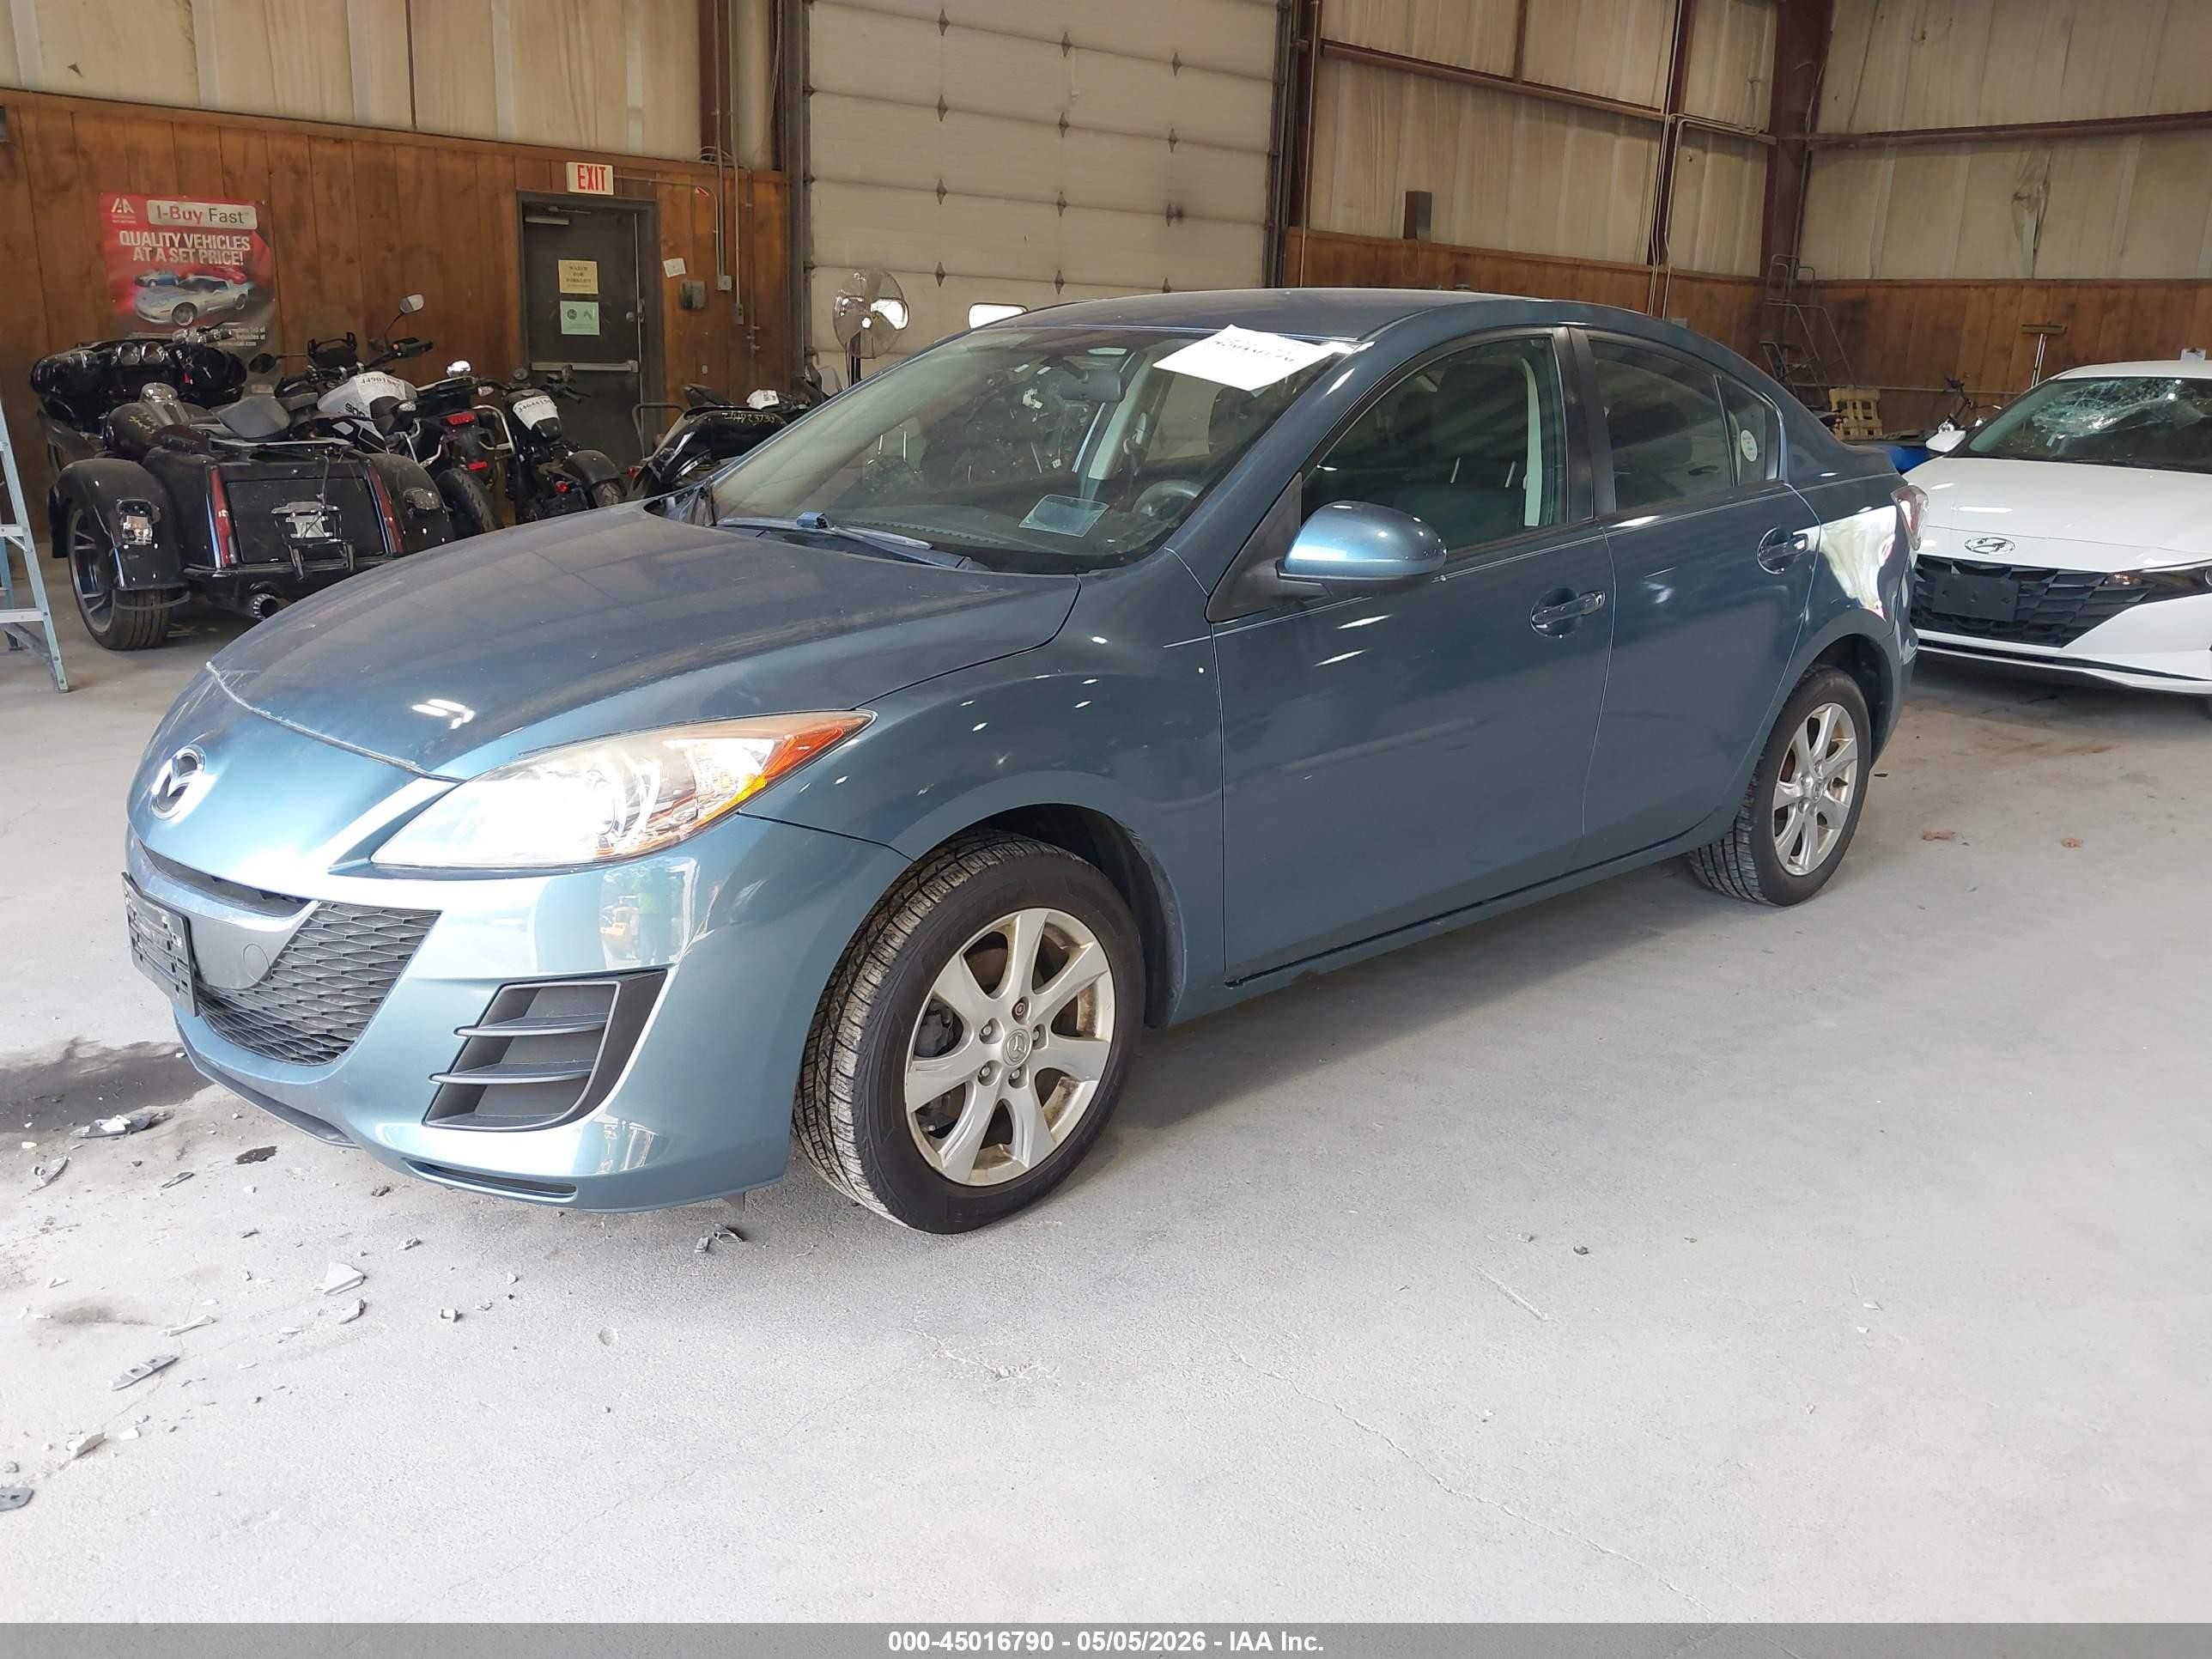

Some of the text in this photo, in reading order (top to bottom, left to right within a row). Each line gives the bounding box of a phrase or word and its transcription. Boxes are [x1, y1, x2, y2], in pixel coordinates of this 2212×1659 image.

[577, 164, 606, 191] EXIT
[157, 205, 245, 225] I-Buy Fast
[118, 230, 251, 252] QUALITY VEHICLES
[133, 246, 245, 265] AT A SET PRICE!
